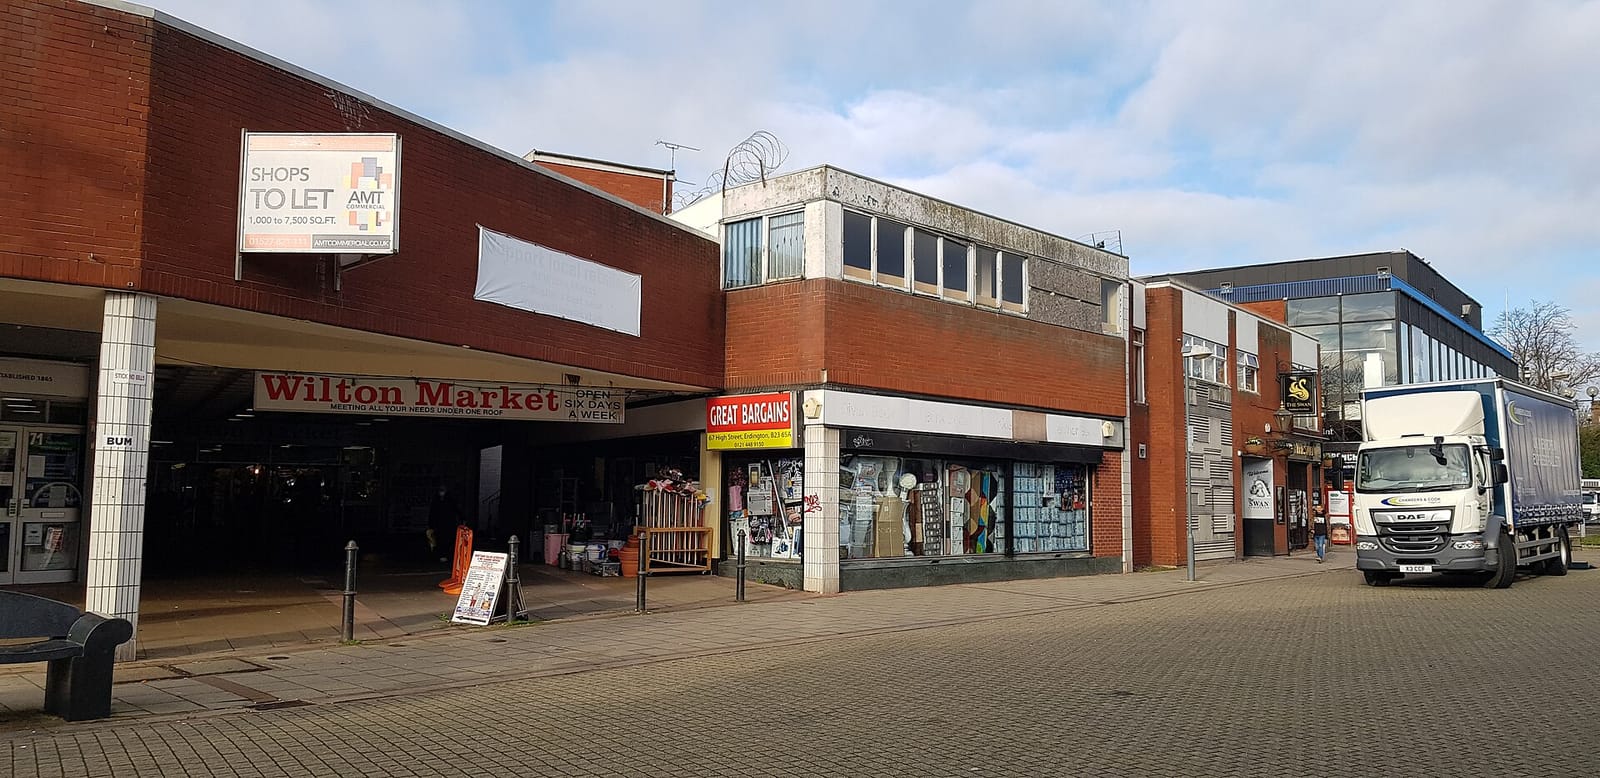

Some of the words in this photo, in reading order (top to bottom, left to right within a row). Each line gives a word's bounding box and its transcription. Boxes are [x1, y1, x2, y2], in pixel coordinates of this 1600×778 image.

[251, 167, 310, 182] SHOPS
[249, 187, 286, 210] TO
[291, 188, 335, 210] LET
[348, 190, 385, 204] AMT
[249, 216, 273, 225] 1,000
[274, 216, 283, 225] to
[284, 216, 308, 225] 7,500
[261, 374, 404, 405] Wilton
[415, 382, 559, 412] Market
[576, 390, 611, 399] OPEN
[330, 403, 367, 411] MEETING
[409, 406, 435, 414] NEEDS
[437, 407, 464, 415] UNDER
[564, 399, 585, 409] SIX
[588, 400, 621, 410] DAYS
[568, 410, 577, 418] A
[581, 410, 617, 420] WEEK
[710, 405, 738, 426] GREAT
[742, 400, 790, 425] BARGAINS
[30, 433, 43, 446] 71
[107, 437, 133, 446] BUM
[715, 434, 728, 442] High
[770, 431, 781, 439] B23
